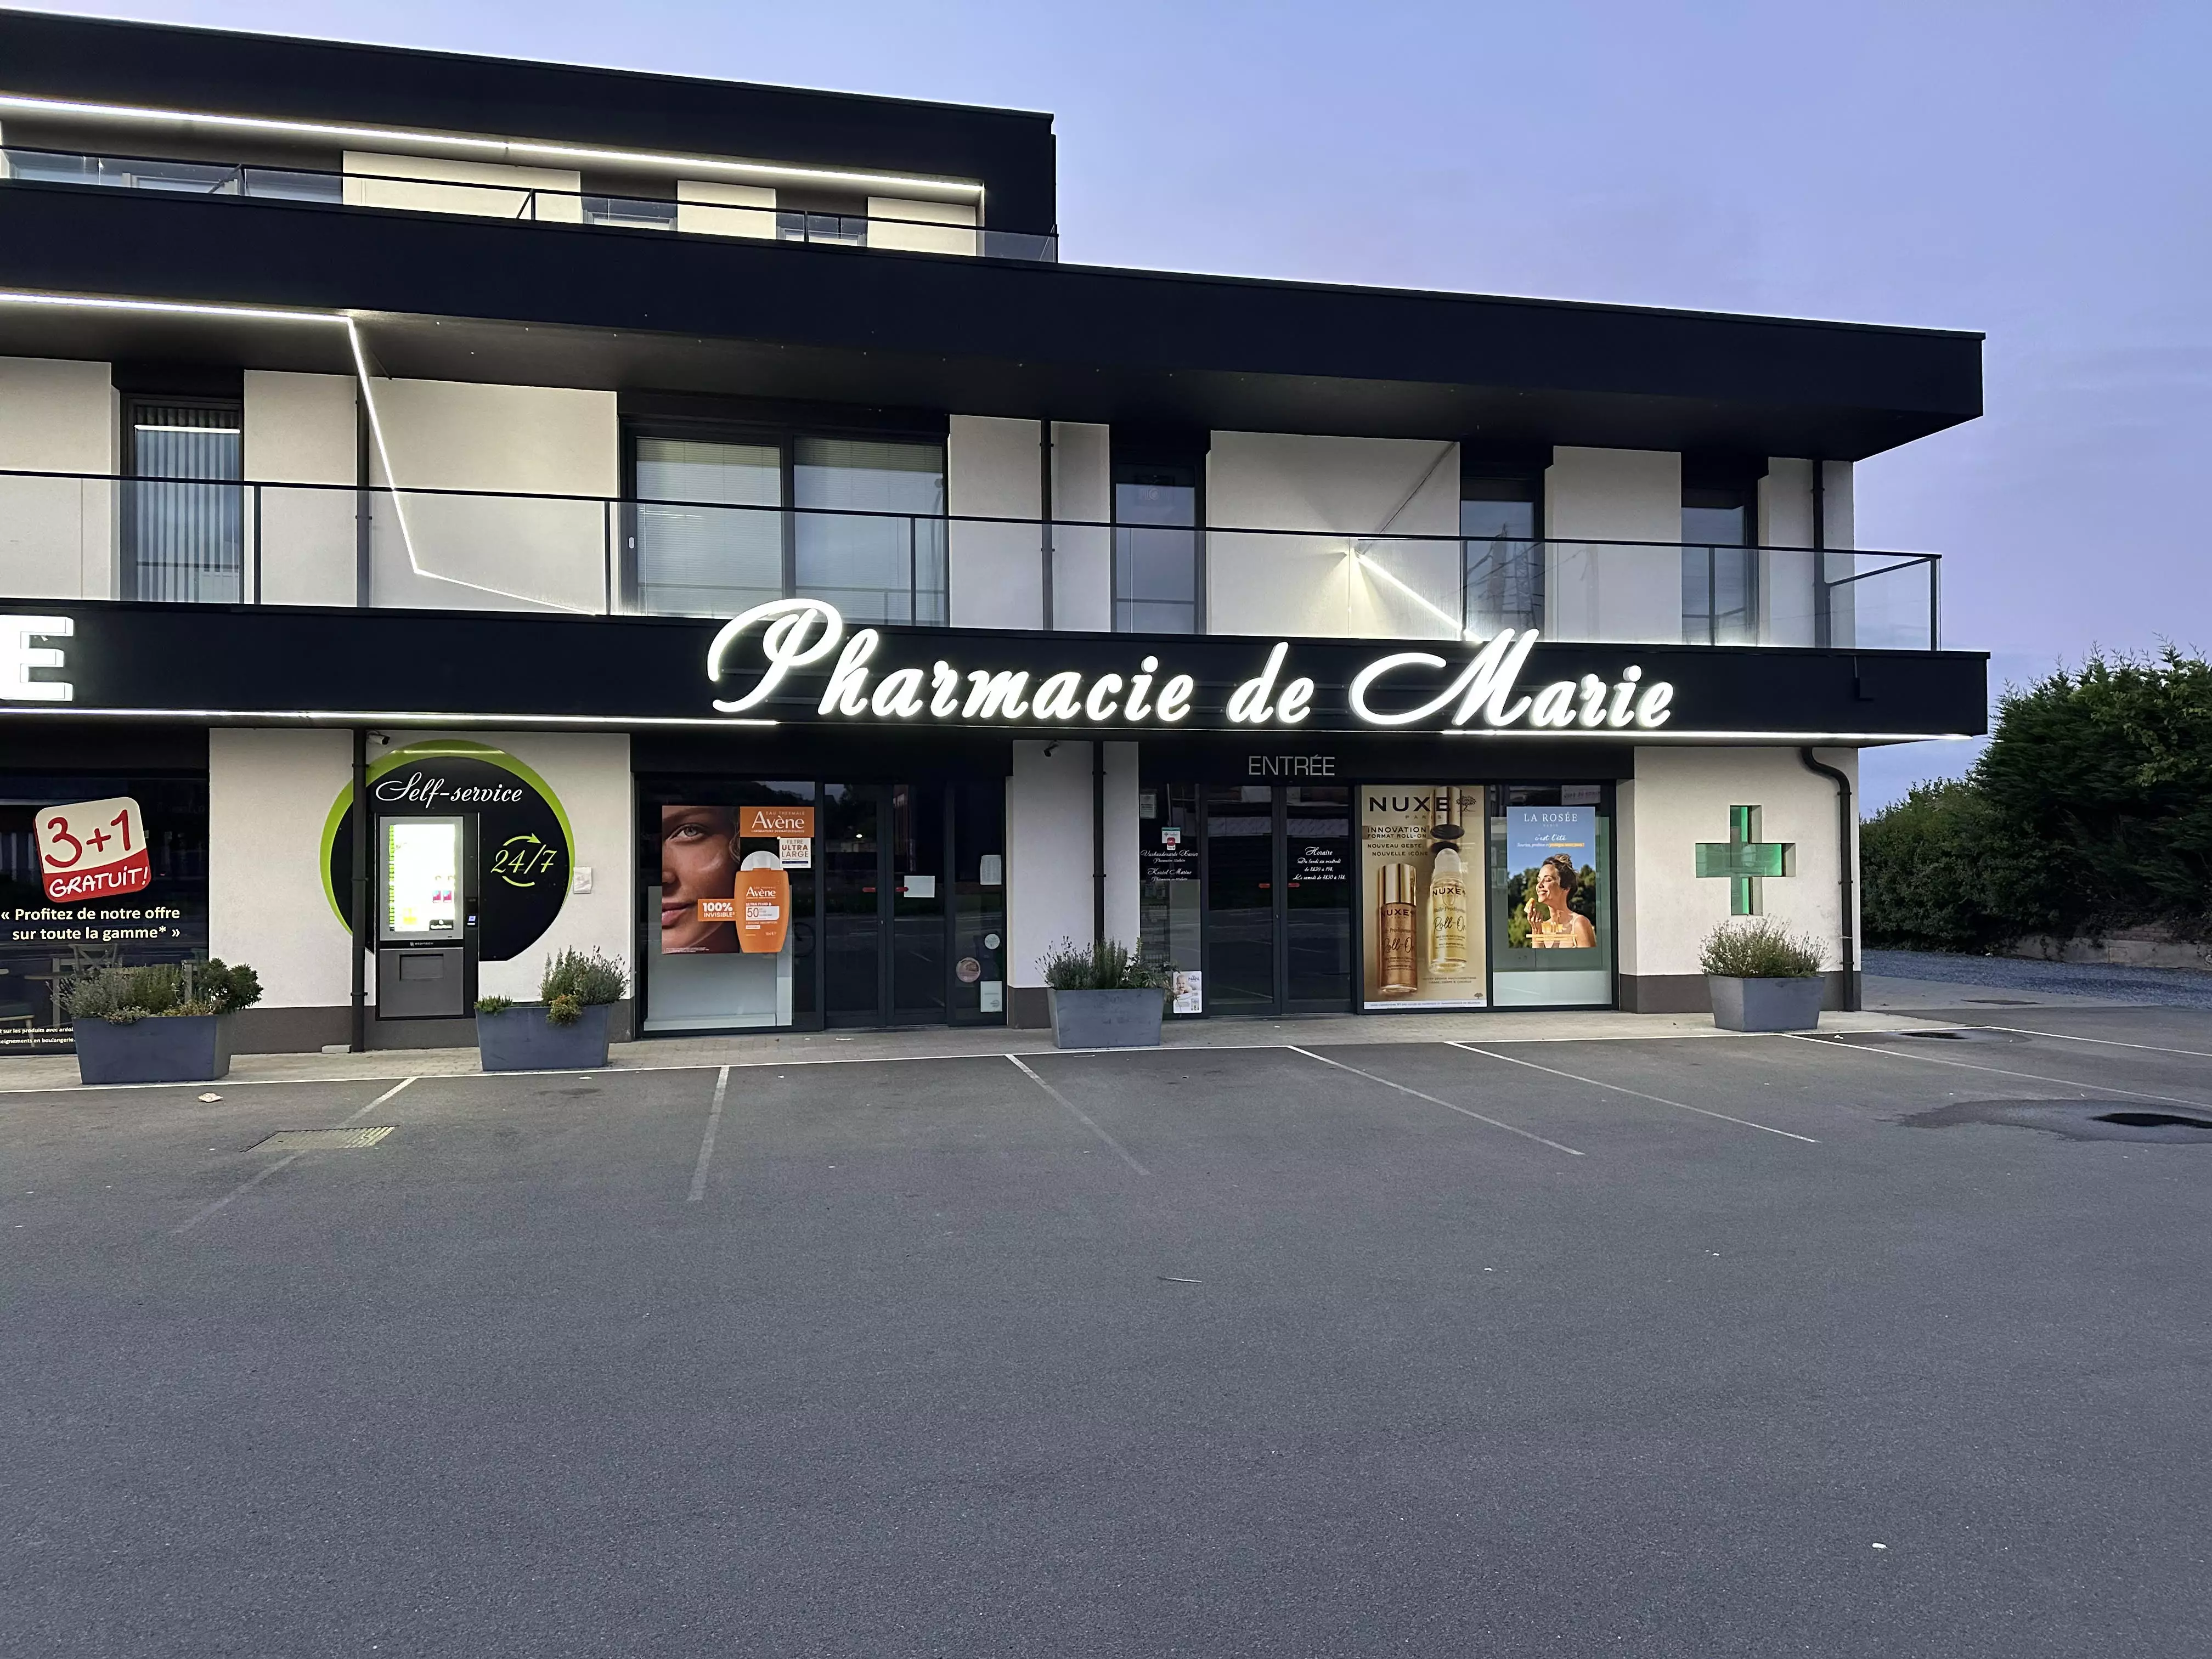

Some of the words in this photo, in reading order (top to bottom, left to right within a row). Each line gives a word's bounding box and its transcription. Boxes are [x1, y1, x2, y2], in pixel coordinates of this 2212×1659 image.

[707, 597, 1195, 722] Pharmacie
[1226, 641, 1314, 724] de
[1348, 628, 1674, 727] Marie
[1248, 754, 1336, 776] ENTRÉE
[375, 771, 522, 809] Self-service
[1369, 797, 1451, 812] NUXE
[752, 811, 805, 829] Avène
[1523, 813, 1537, 822] LA
[1542, 812, 1578, 822] ROSÉE
[44, 809, 131, 868] 3+1
[1305, 847, 1333, 856] Horaire
[490, 844, 557, 874] 24/7
[746, 886, 776, 897] Avène
[1432, 887, 1462, 897] NUXE
[15, 908, 73, 921] Profitez
[77, 907, 96, 919] de
[100, 910, 140, 919] notre
[145, 907, 180, 919] offre
[702, 902, 733, 912] 100%
[747, 907, 759, 918] 50
[13, 929, 37, 940] sur
[40, 928, 81, 940] toute
[86, 927, 98, 939] la
